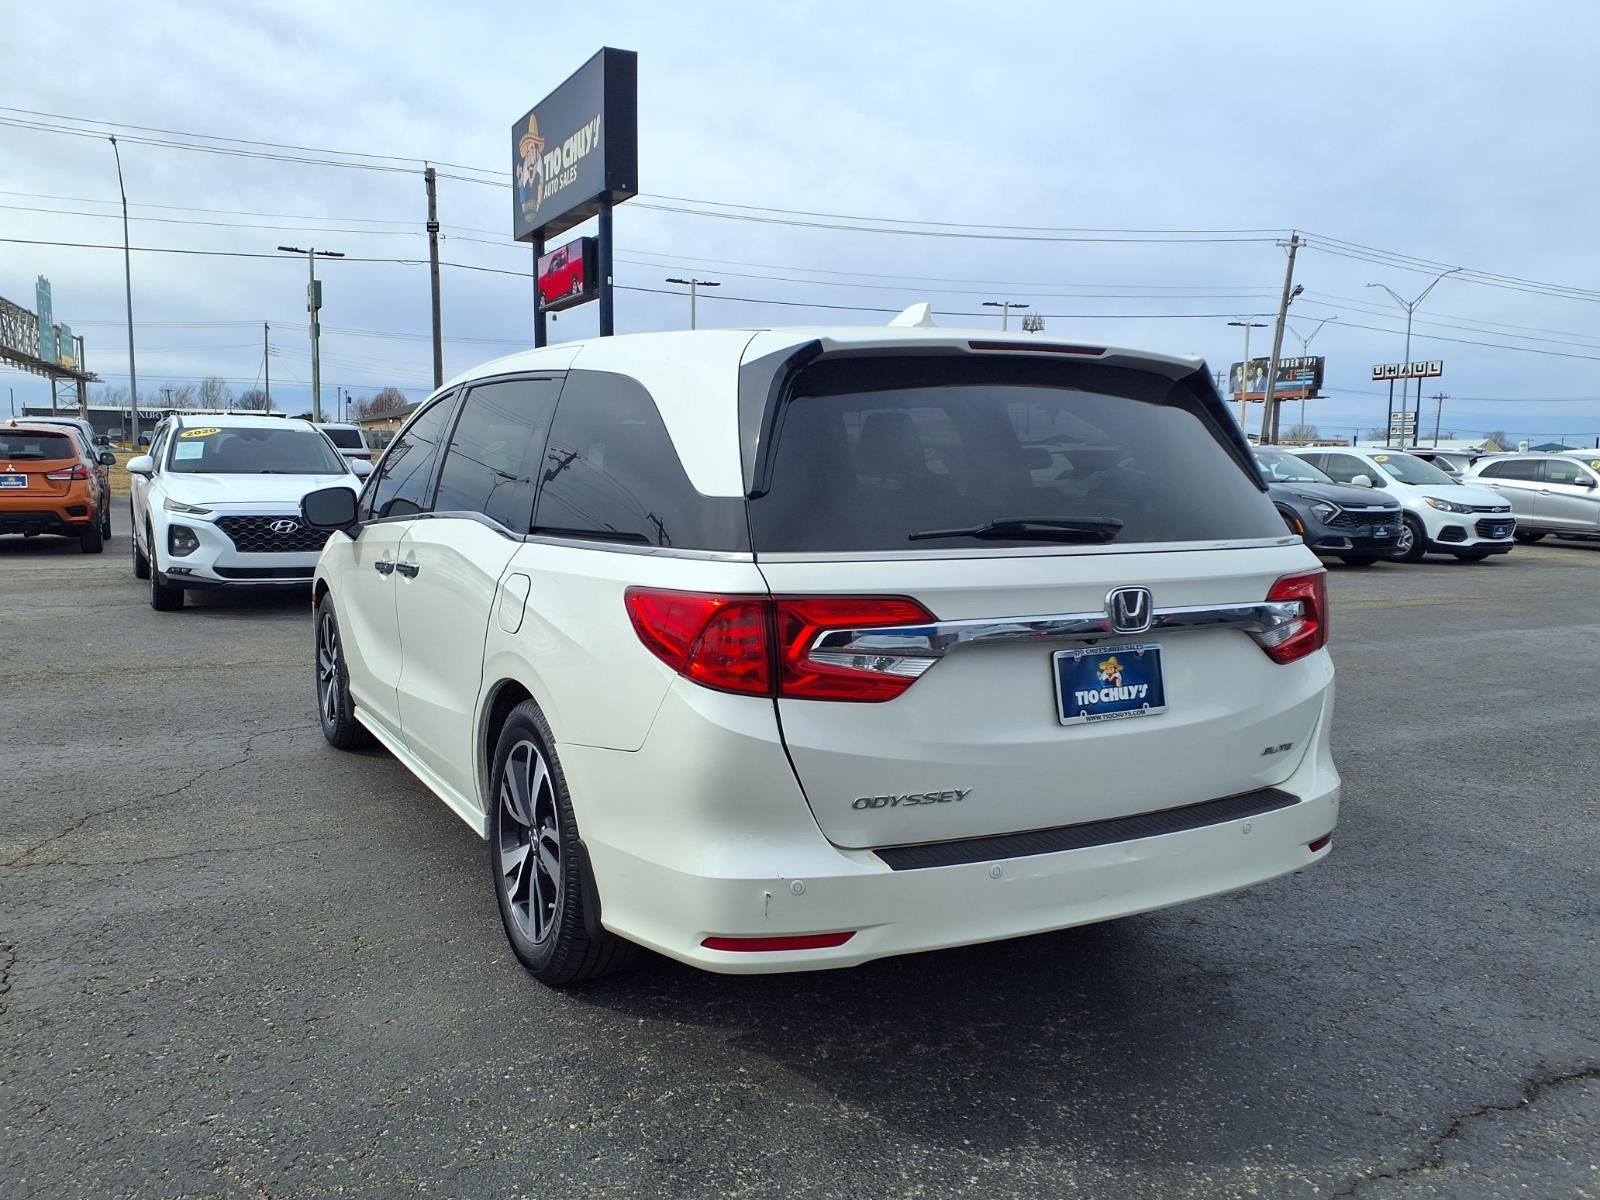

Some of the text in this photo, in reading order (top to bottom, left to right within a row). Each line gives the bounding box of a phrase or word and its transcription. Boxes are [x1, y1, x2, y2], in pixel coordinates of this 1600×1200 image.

[544, 113, 600, 181] TIO CHUY'S
[543, 164, 577, 200] AUTO SALES
[1267, 358, 1300, 369] TNDER
[124, 410, 166, 419] LXURY
[186, 428, 217, 437] 2020
[1075, 683, 1148, 706] TIO CHUY'S
[1086, 709, 1146, 722] WWW.TIOCHUYS.COM
[851, 785, 973, 810] ODYSSEY
